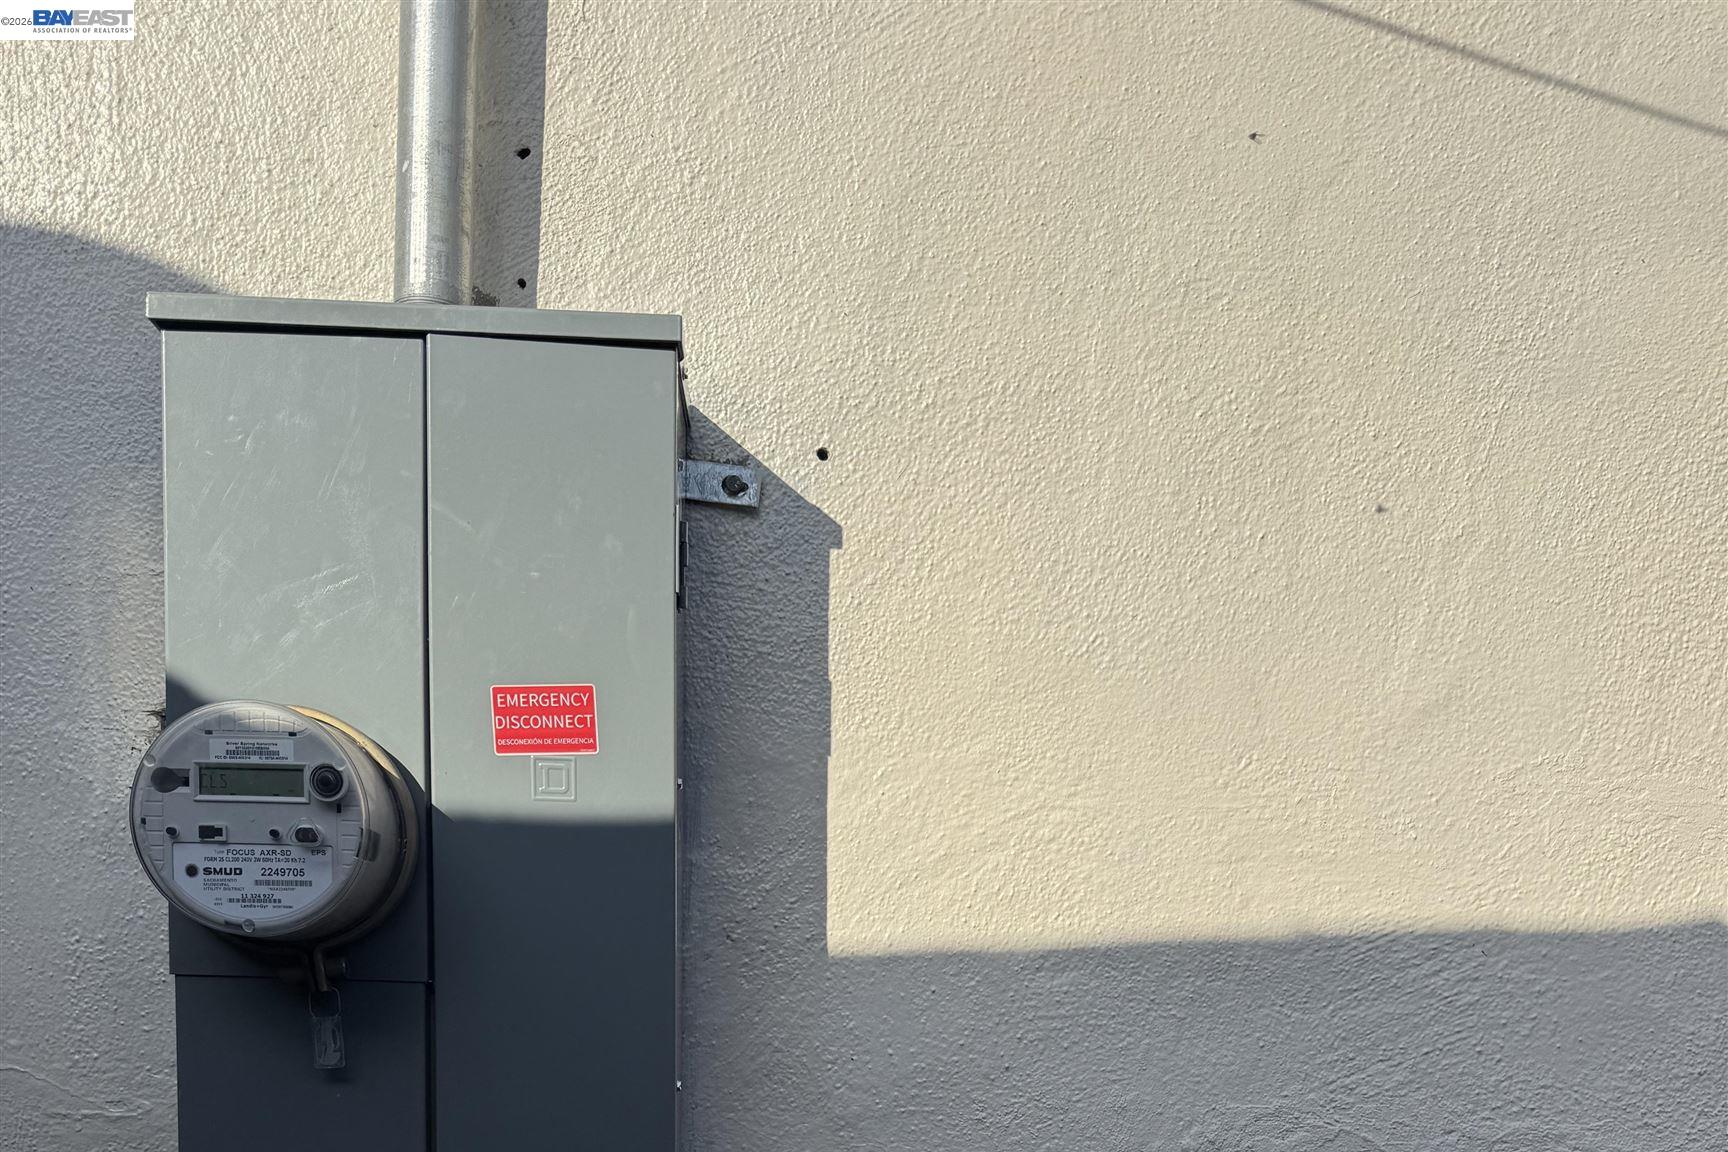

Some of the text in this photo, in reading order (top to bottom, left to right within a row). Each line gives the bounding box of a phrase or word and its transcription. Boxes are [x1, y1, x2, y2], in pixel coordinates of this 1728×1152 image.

[497, 693, 589, 707] EMERGENCY
[495, 715, 593, 729] DISCONNECT
[259, 849, 291, 857] AXR-SD
[202, 867, 305, 877] SMUD 2249705
